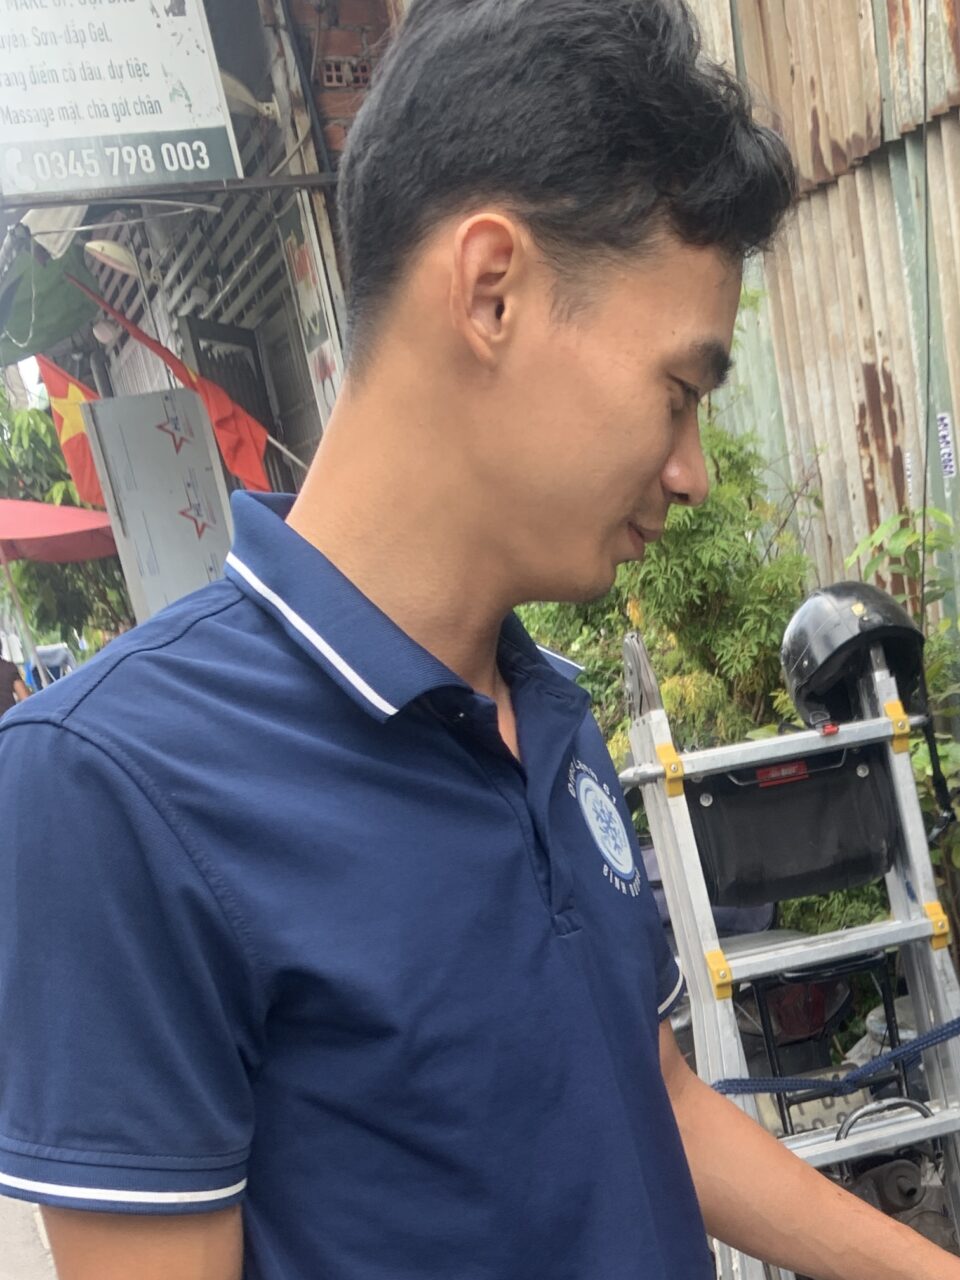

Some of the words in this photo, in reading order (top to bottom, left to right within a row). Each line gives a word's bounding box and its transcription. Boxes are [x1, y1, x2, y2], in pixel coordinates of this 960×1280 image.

[126, 57, 151, 83] tiệc
[34, 149, 99, 180] 0345
[105, 146, 155, 176] 798
[161, 140, 210, 171] 003
